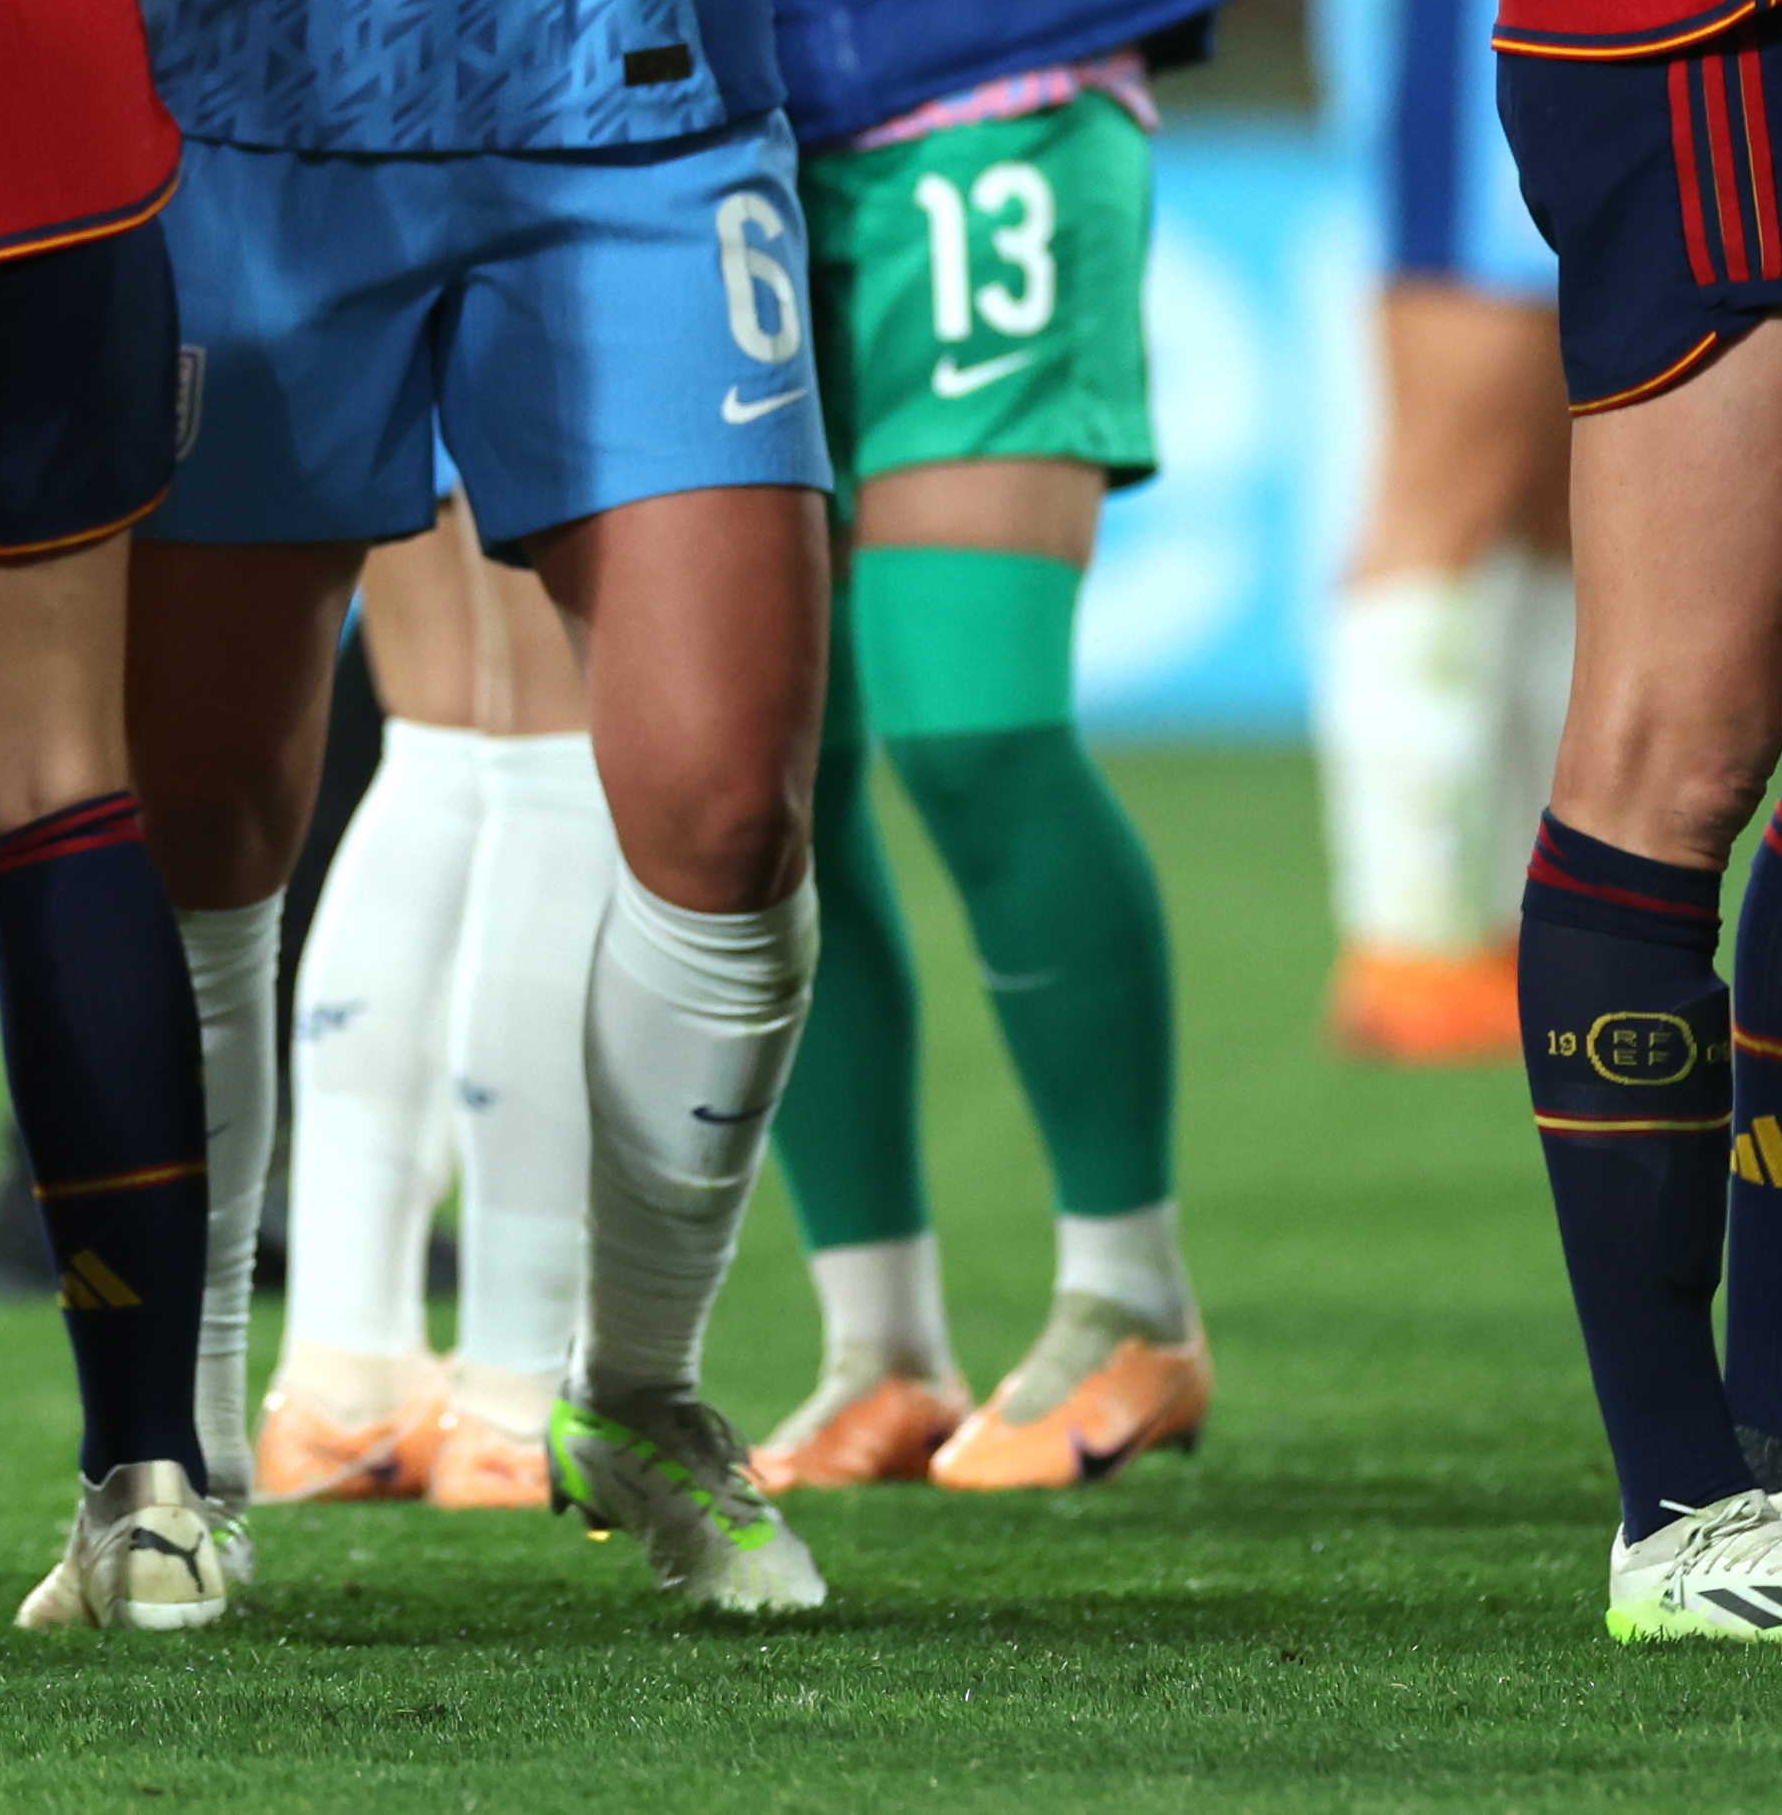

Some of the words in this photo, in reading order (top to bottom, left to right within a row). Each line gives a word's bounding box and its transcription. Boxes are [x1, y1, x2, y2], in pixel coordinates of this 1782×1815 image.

[714, 192, 802, 364] 6
[914, 162, 1056, 343] 13
[1547, 1029, 1578, 1058] 19
